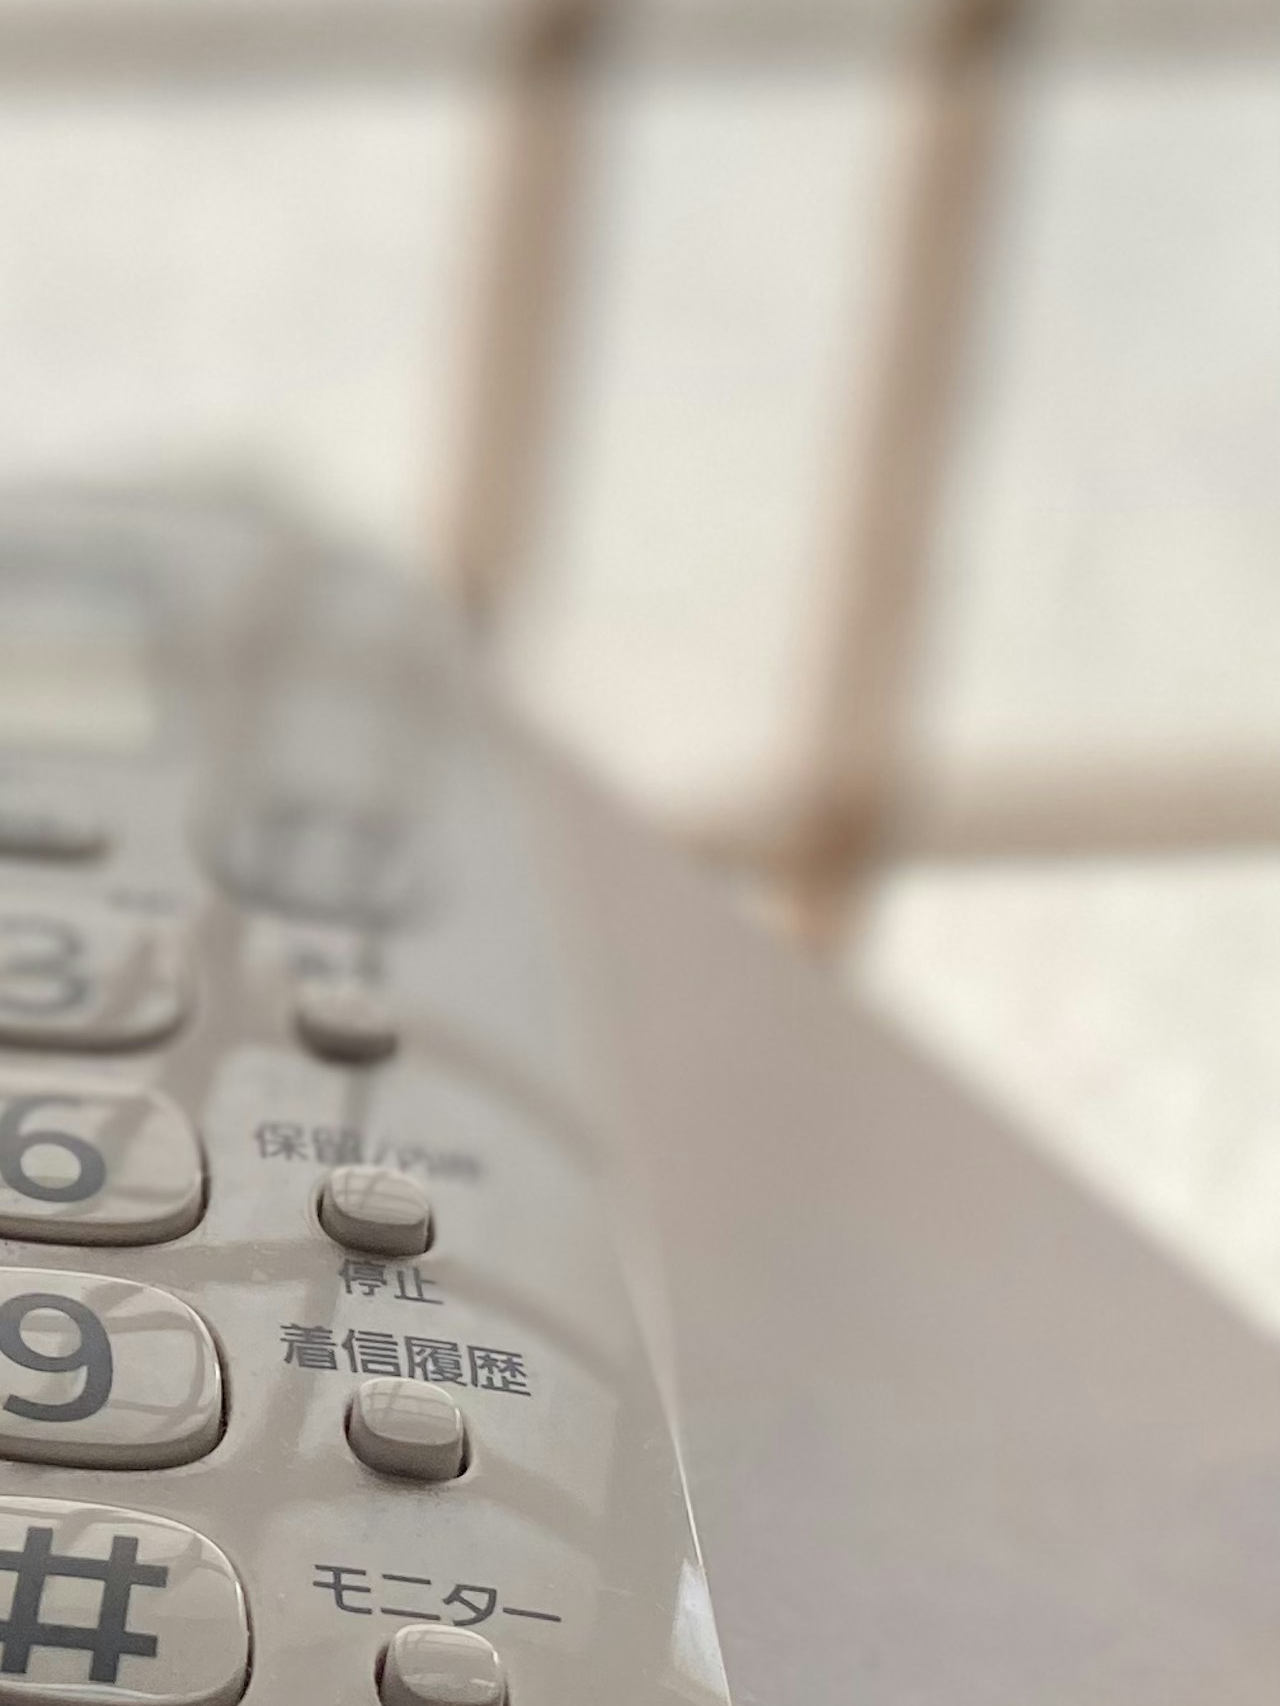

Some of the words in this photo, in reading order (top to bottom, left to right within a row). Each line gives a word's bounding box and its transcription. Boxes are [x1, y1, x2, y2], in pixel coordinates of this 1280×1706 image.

[279, 1323, 532, 1398] 着信履歴
[313, 1564, 562, 1628] モニター
